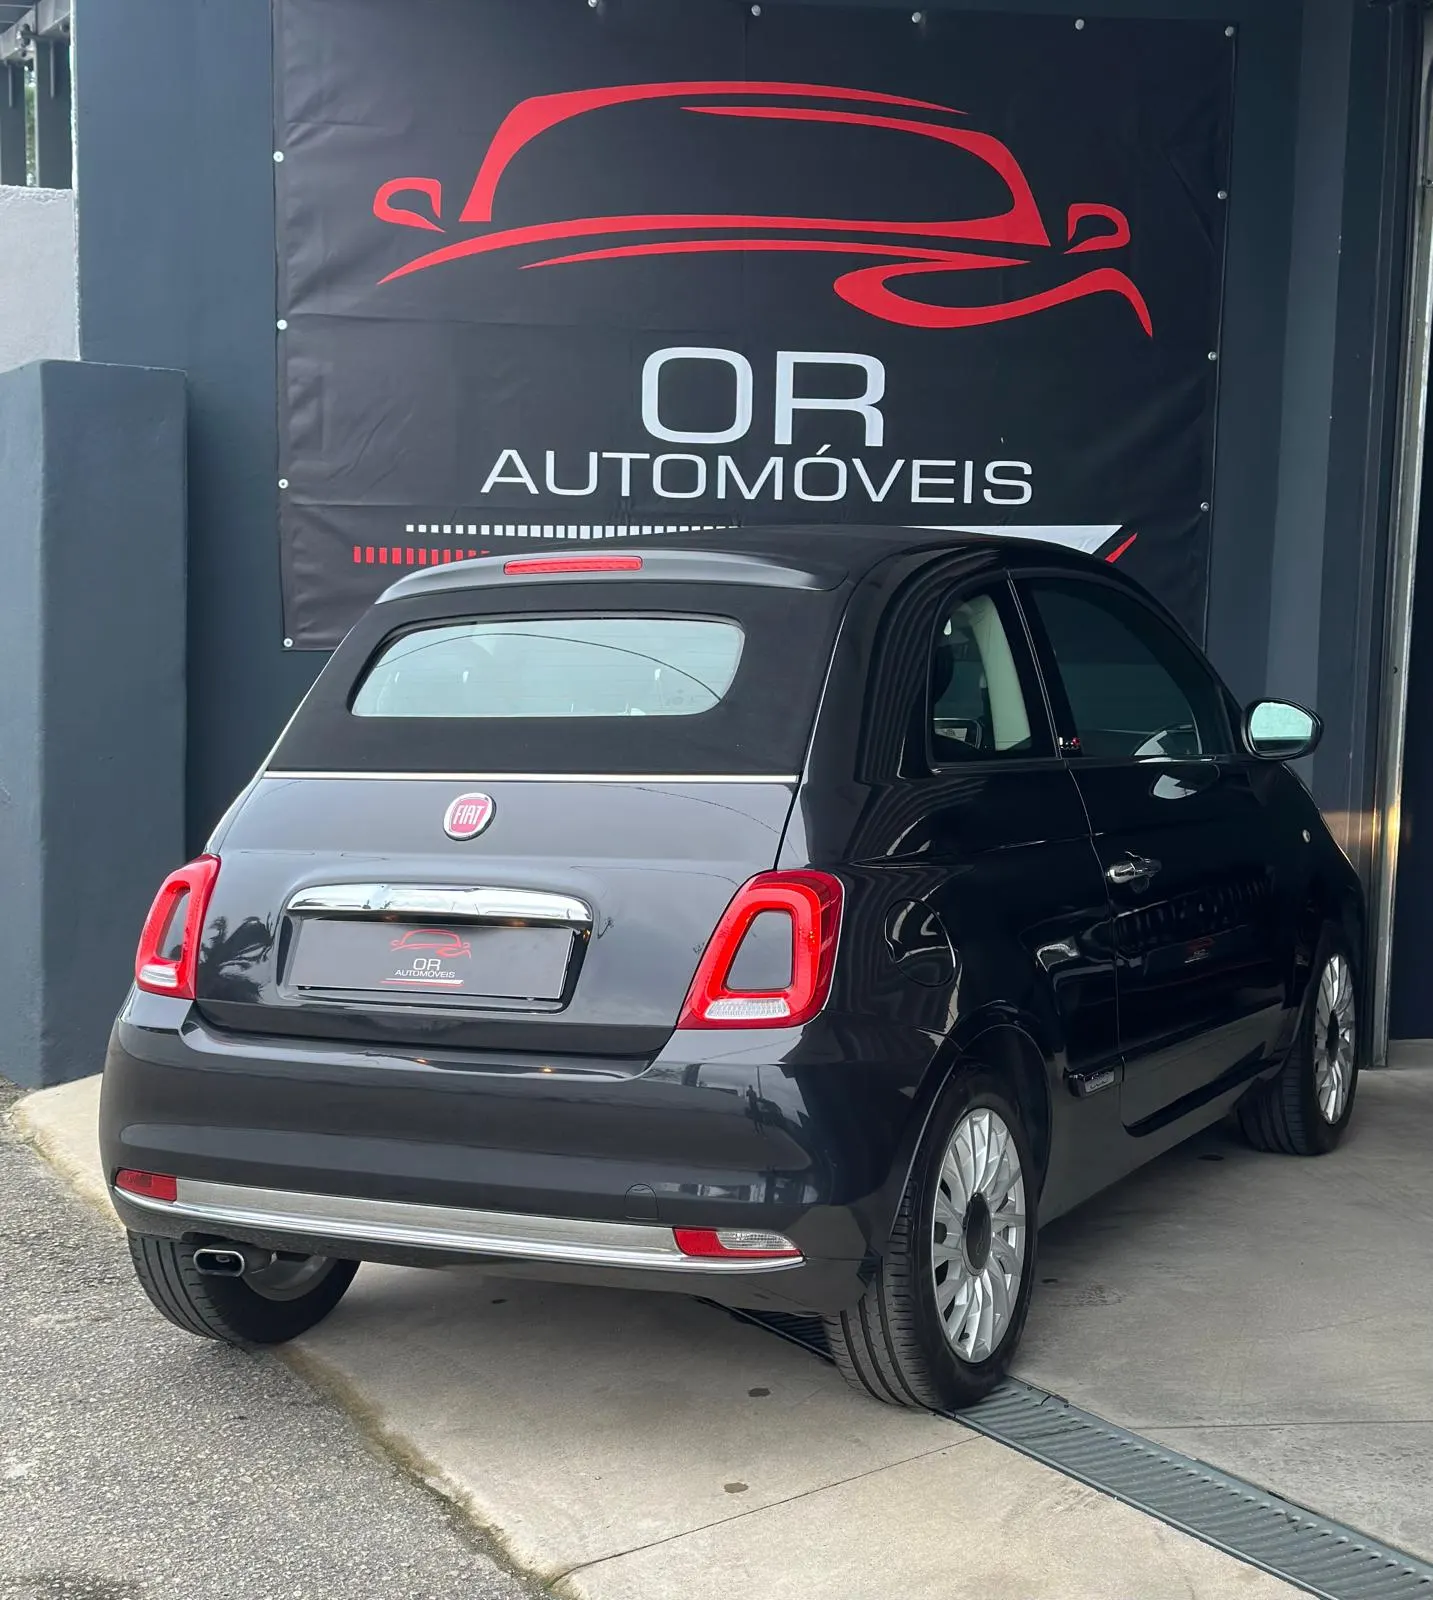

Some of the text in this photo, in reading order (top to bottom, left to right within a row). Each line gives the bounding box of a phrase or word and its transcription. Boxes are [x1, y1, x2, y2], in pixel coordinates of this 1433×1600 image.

[641, 347, 886, 447] OR
[480, 444, 1033, 505] AUTOMÓVEIS
[452, 804, 486, 825] FIAT
[413, 958, 441, 971] OR
